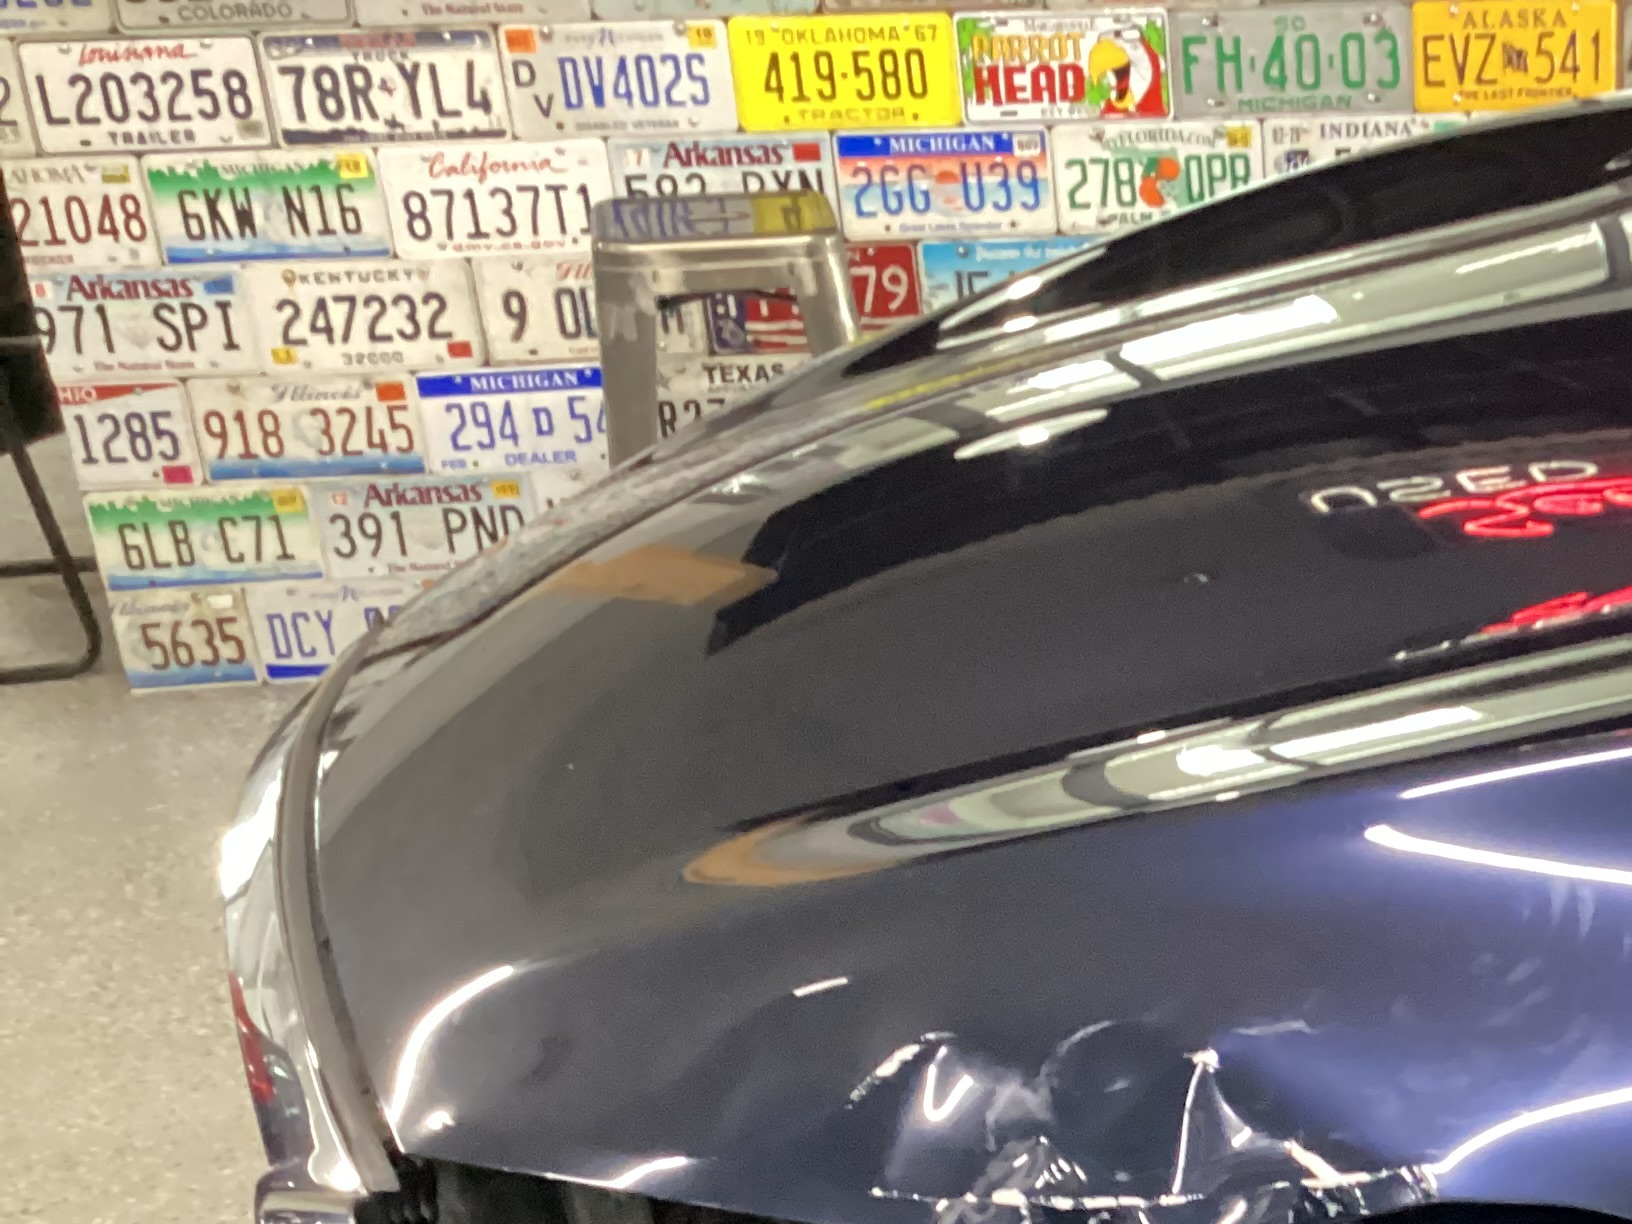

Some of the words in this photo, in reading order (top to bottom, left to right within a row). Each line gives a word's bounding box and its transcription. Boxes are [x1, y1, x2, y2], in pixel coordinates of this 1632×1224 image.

[178, 3, 293, 21] COLORADO
[1462, 8, 1568, 30] ALASKA
[781, 26, 901, 45] OKLAHOMA
[915, 24, 938, 42] 67
[970, 32, 1086, 64] PARROT
[79, 42, 199, 66] Louisiana
[1422, 32, 1499, 88] EVZ
[1533, 29, 1601, 85] 541
[511, 59, 537, 88] D
[973, 62, 1087, 107] HEAD
[34, 68, 254, 126] L203258
[1238, 95, 1352, 112] MICHIGAN
[798, 106, 906, 122] TRACTOR
[1319, 118, 1416, 139] INDIANA
[107, 129, 197, 146] TRAILER
[663, 139, 785, 169] Arkansas
[889, 133, 996, 153] MICHIGAN
[428, 151, 570, 185] California
[1064, 156, 1137, 210] 278
[851, 163, 932, 219] 2GG
[959, 158, 1042, 213] U39
[10, 193, 148, 247] 21048
[177, 186, 258, 241] 6KW
[280, 183, 363, 237] N16
[66, 273, 195, 301] Arkansas
[299, 268, 414, 285] KENTUCKY
[850, 264, 910, 314] 79
[34, 302, 116, 355] 971
[152, 299, 242, 354] SPI
[275, 291, 454, 346] 247232
[502, 287, 528, 343] 9
[469, 369, 579, 391] MICHIGAN
[702, 361, 785, 386] TEXAS
[57, 385, 98, 403] HIO
[73, 410, 181, 465] 1285
[203, 409, 285, 461] 918
[310, 403, 415, 457] 3245
[444, 399, 520, 452] 294
[504, 450, 577, 466] DEALER
[363, 480, 484, 509] Arkansas
[117, 519, 196, 570] 6LB
[217, 514, 296, 564] C71
[328, 509, 408, 560] 391
[140, 616, 247, 670] 5635
[265, 609, 336, 660] DCY
